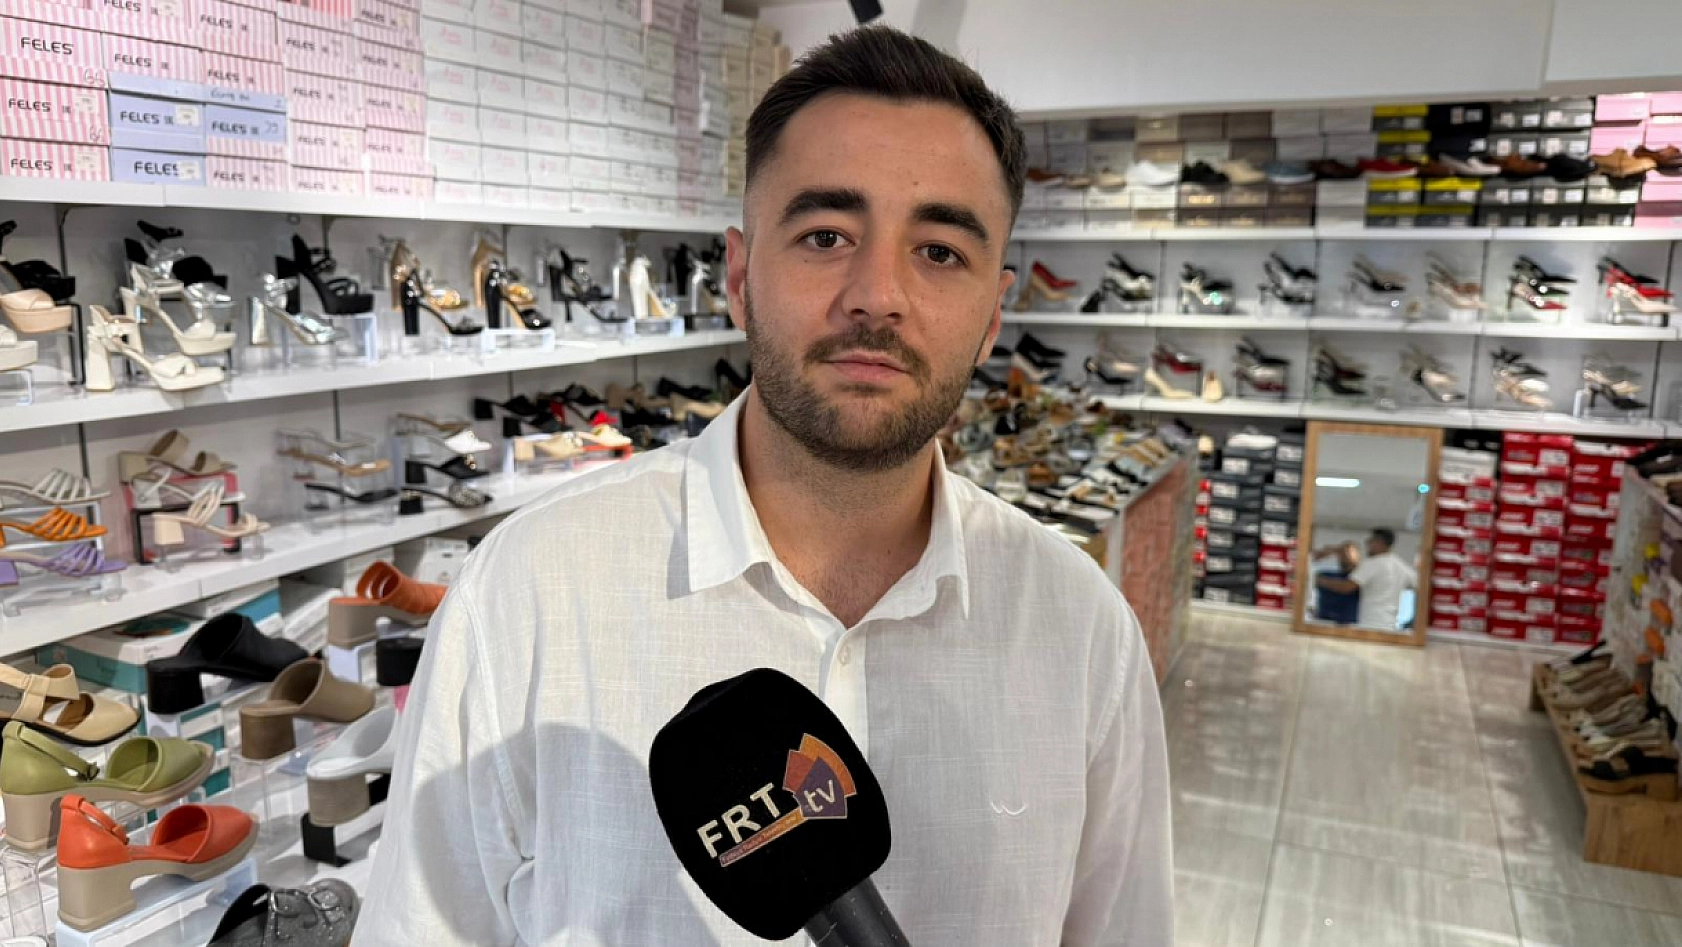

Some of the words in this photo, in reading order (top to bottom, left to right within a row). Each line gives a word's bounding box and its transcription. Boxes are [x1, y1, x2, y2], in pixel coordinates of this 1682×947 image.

[20, 36, 74, 55] FELES
[114, 53, 151, 67] FELES
[8, 97, 52, 112] FELES
[120, 110, 160, 124] FELES
[212, 121, 247, 135] FELES
[10, 158, 53, 171] FELES
[696, 782, 780, 859] FRT
[803, 779, 836, 813] tv
